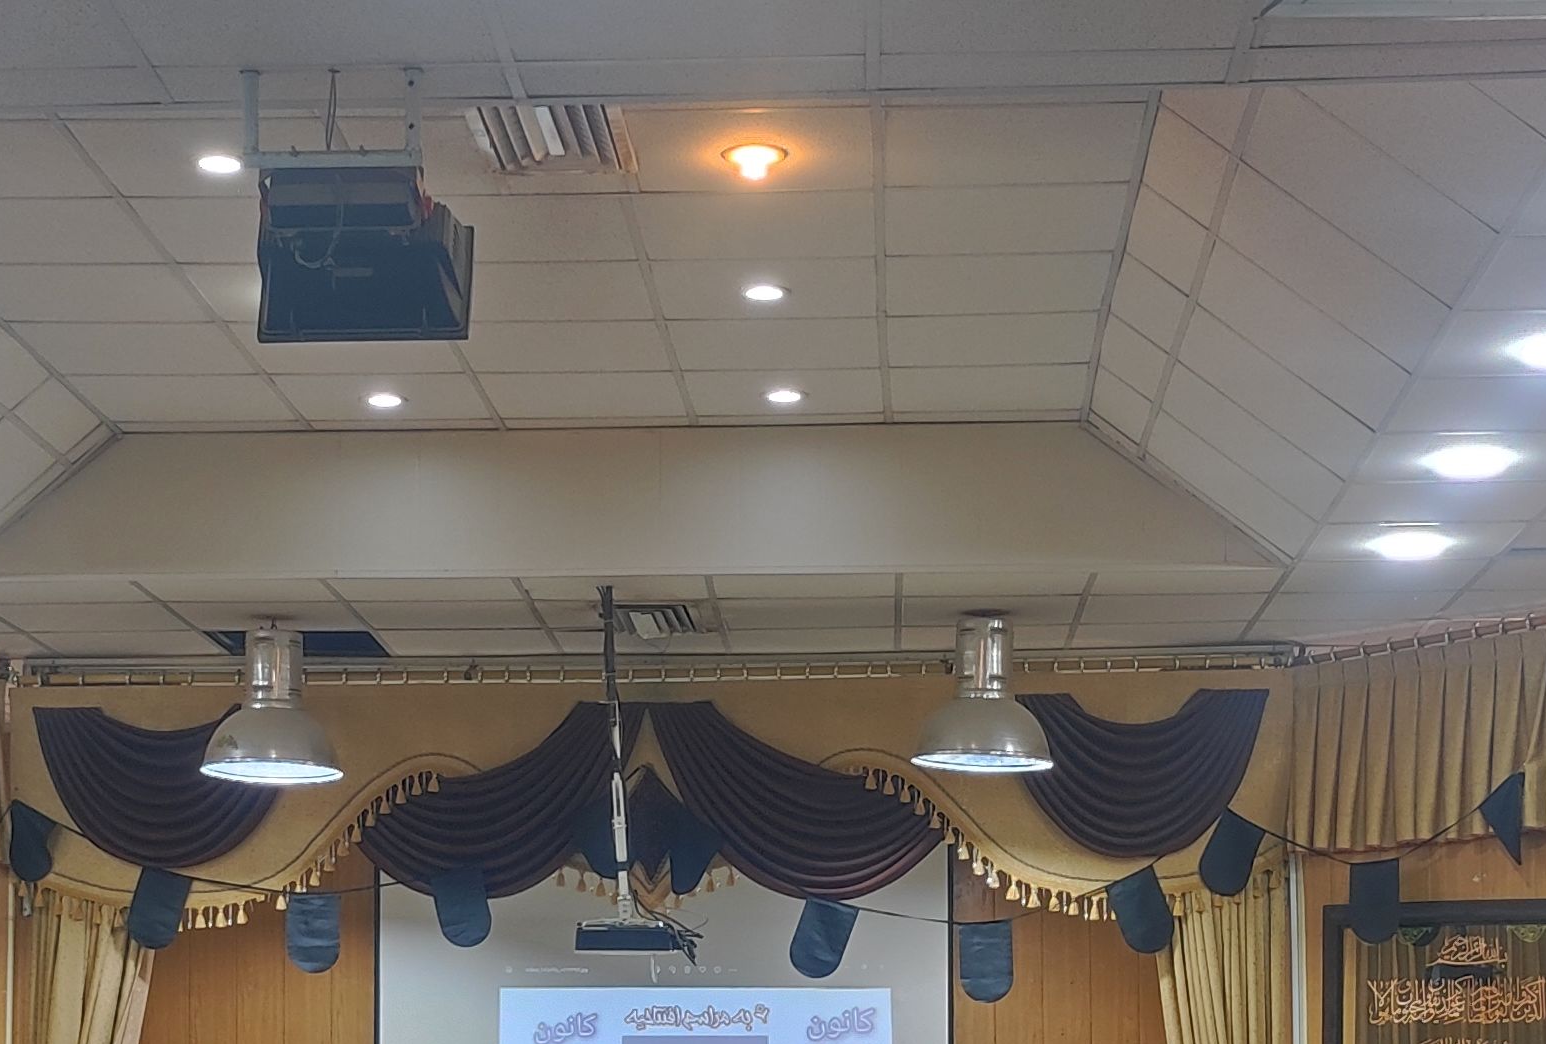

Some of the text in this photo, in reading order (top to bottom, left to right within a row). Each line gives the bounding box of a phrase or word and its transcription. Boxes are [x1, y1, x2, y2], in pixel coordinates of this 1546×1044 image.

[534, 1012, 598, 1044] کانون
[624, 1005, 753, 1031] به مراسم افتتاحیه
[807, 1006, 875, 1041] کانون
